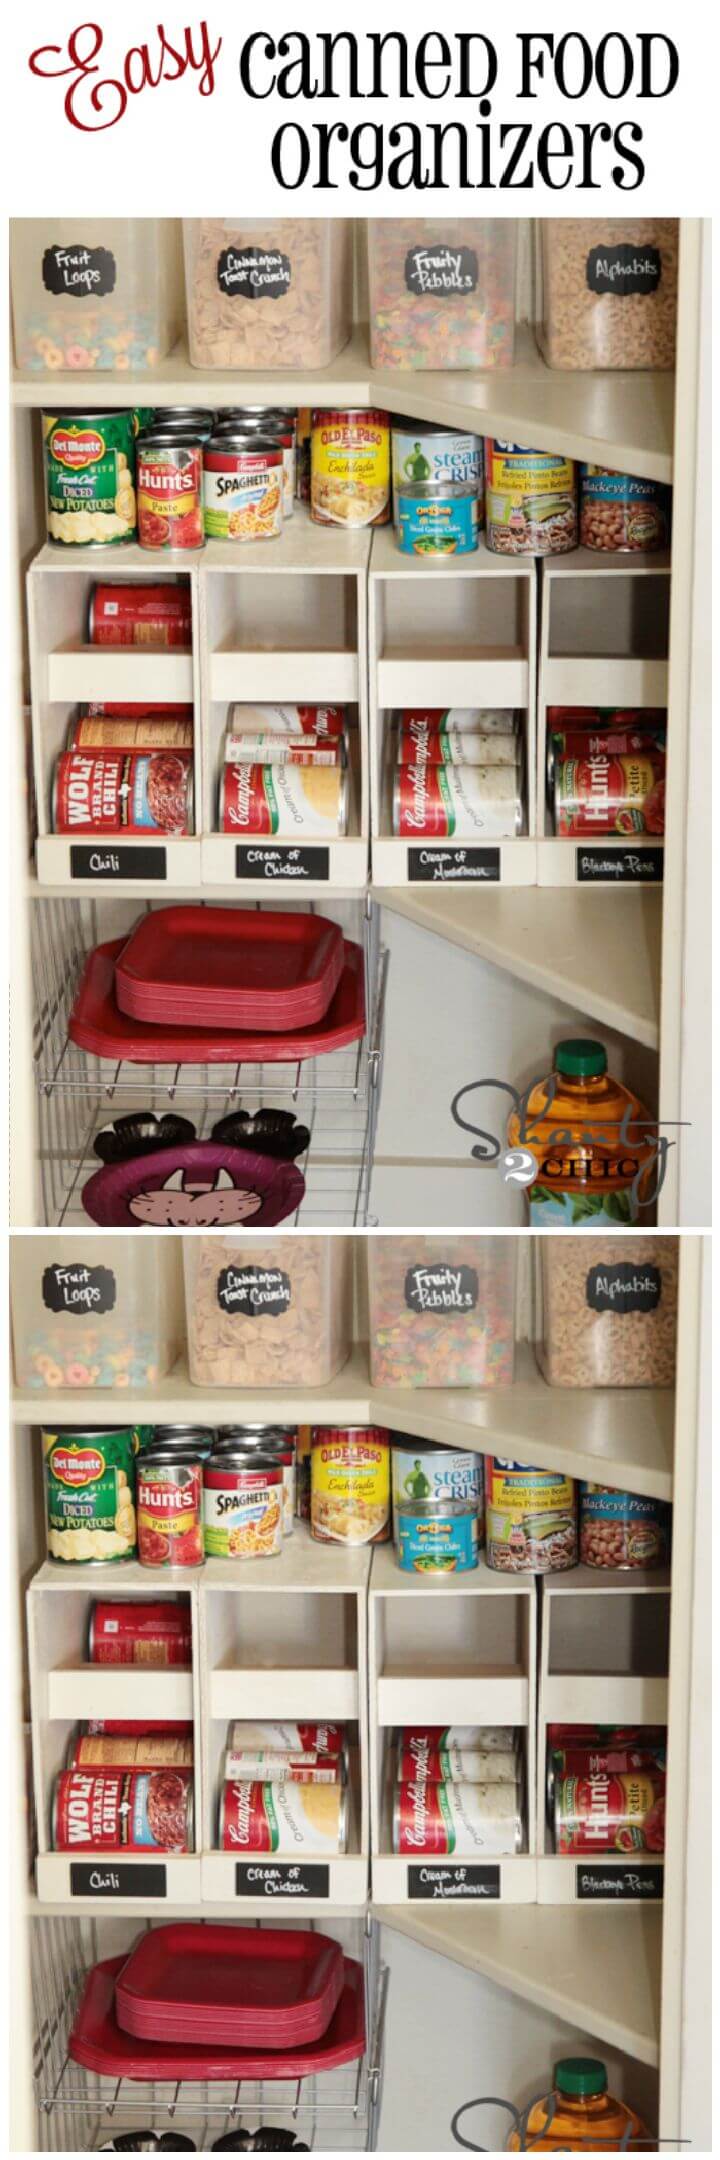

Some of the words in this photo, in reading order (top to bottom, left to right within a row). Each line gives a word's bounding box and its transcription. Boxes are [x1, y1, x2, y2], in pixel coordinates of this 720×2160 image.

[412, 250, 461, 277] Fruity
[595, 257, 657, 281] Alphabits
[64, 269, 101, 290] Loops
[249, 270, 290, 286] Crunch
[410, 271, 472, 291] Pebbles
[68, 439, 100, 452] Monte
[62, 485, 93, 499] DICED
[66, 498, 114, 511] POTATOES
[152, 501, 178, 512] Paste
[68, 755, 95, 826] WOLF
[92, 759, 105, 818] BRAND
[103, 761, 119, 816] CHILI
[89, 853, 119, 871] Chili
[247, 850, 281, 862] Cream
[419, 851, 452, 865] Cream
[412, 1268, 461, 1295] Fruity
[595, 1275, 657, 1299] Alphabits
[64, 1287, 101, 1308] Loops
[249, 1288, 290, 1304] Crunch
[410, 1289, 472, 1309] Pebbles
[68, 1457, 100, 1470] Monte
[62, 1503, 93, 1517] DICED
[66, 1516, 114, 1529] POTATOES
[152, 1519, 178, 1530] Paste
[68, 1773, 95, 1844] WOLF
[92, 1777, 105, 1836] BRAND
[103, 1779, 119, 1834] CHILI
[89, 1871, 119, 1889] Chili
[247, 1868, 281, 1880] Cream
[419, 1869, 452, 1883] Cream
